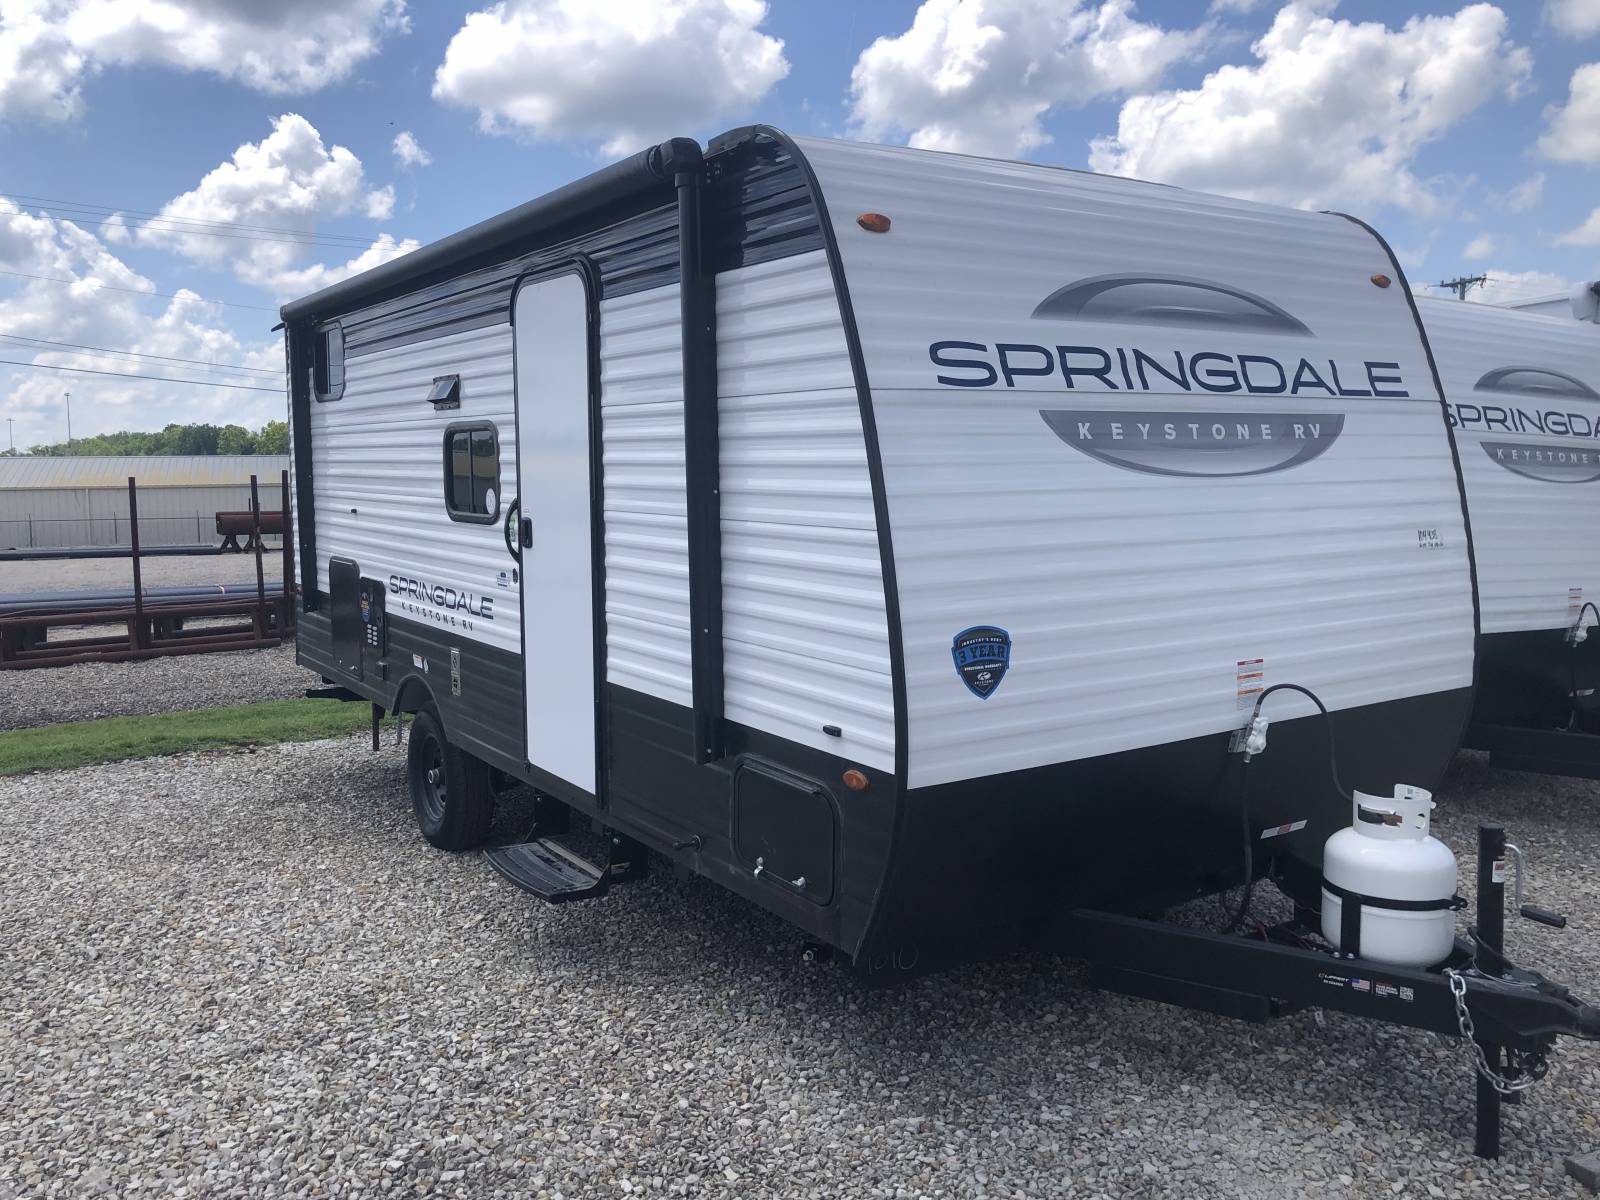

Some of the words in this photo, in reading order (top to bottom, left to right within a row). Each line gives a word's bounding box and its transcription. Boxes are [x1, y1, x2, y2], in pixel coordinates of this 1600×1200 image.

[929, 341, 1409, 397] SPRINGDALE
[1077, 422, 1272, 440] KEYSTONE
[1293, 422, 1321, 440] RV
[1496, 448, 1589, 464] KEYSTONE
[389, 575, 494, 620] SPRINGDALE
[401, 601, 456, 627] KEYSTONE
[462, 621, 473, 631] RV
[958, 650, 966, 663] 3
[969, 644, 1005, 658] YEAR
